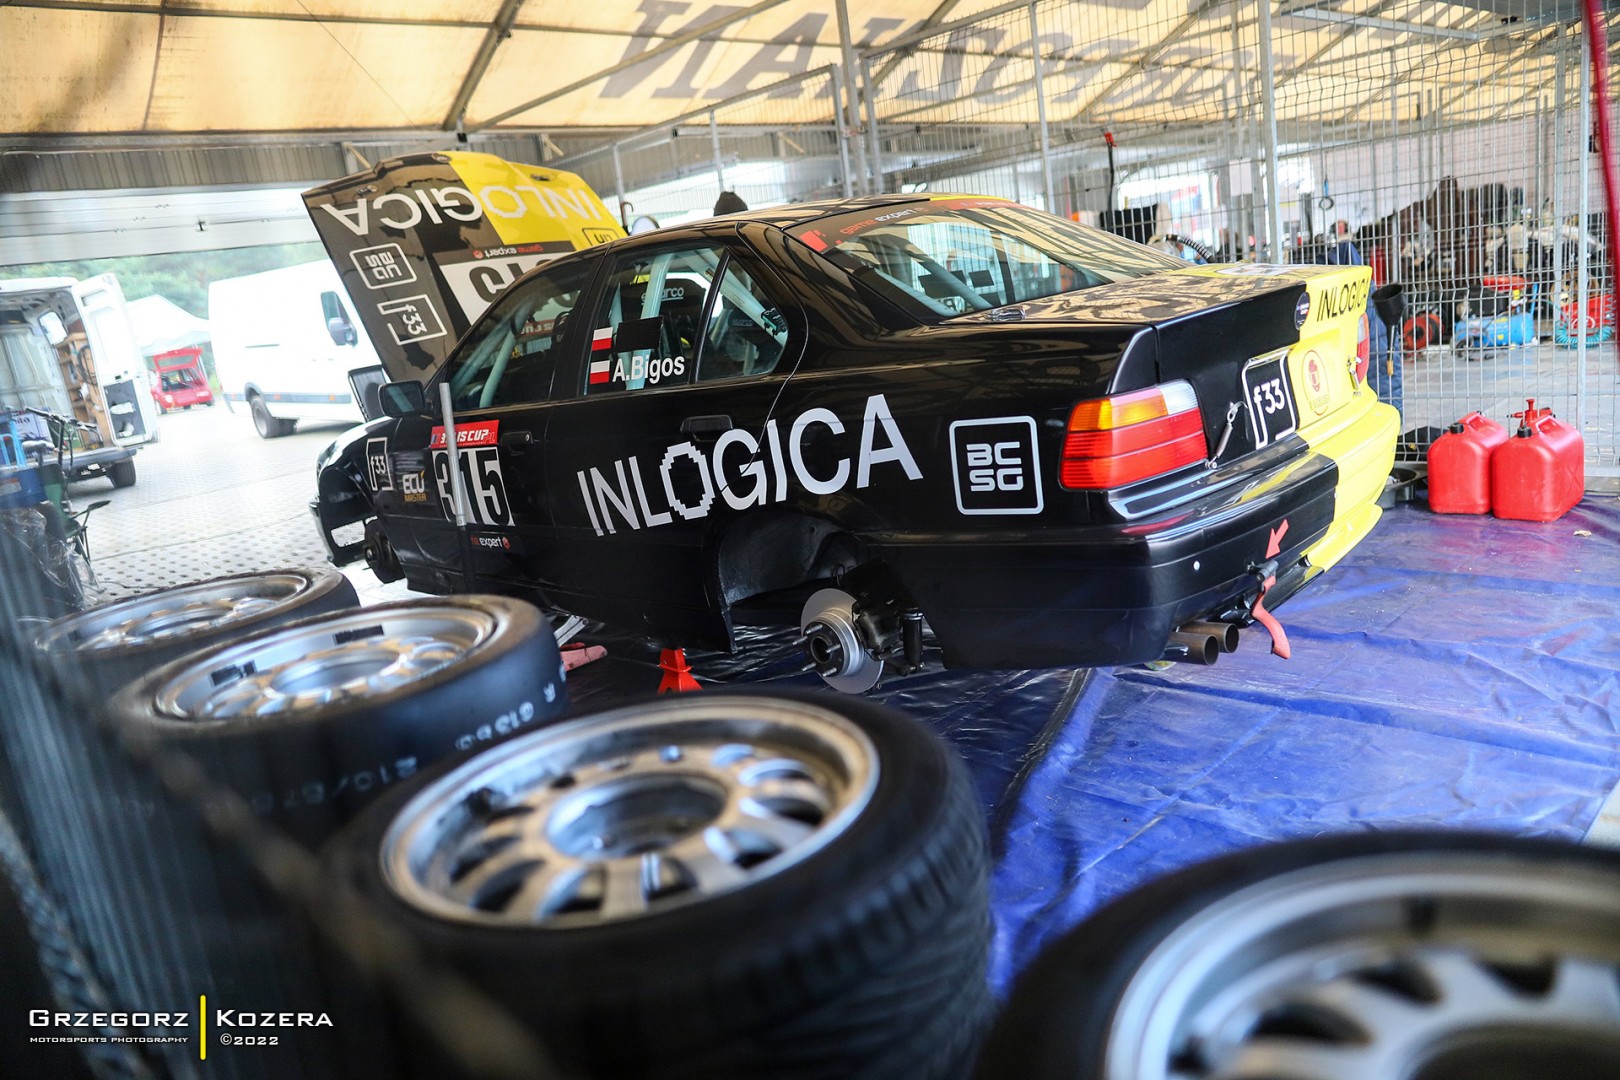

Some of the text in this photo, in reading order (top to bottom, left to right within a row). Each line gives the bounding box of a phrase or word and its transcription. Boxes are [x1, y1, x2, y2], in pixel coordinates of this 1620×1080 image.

[320, 185, 602, 236] INLOGICA
[875, 208, 918, 221] expert
[484, 247, 517, 258] expert
[397, 303, 427, 336] f33
[612, 355, 685, 384] A.Bigos
[1254, 378, 1285, 414] f33
[467, 429, 489, 441] CUP
[370, 455, 387, 475] f33
[577, 394, 924, 536] INLOGICA
[403, 472, 425, 494] ECU
[479, 536, 502, 548] expert
